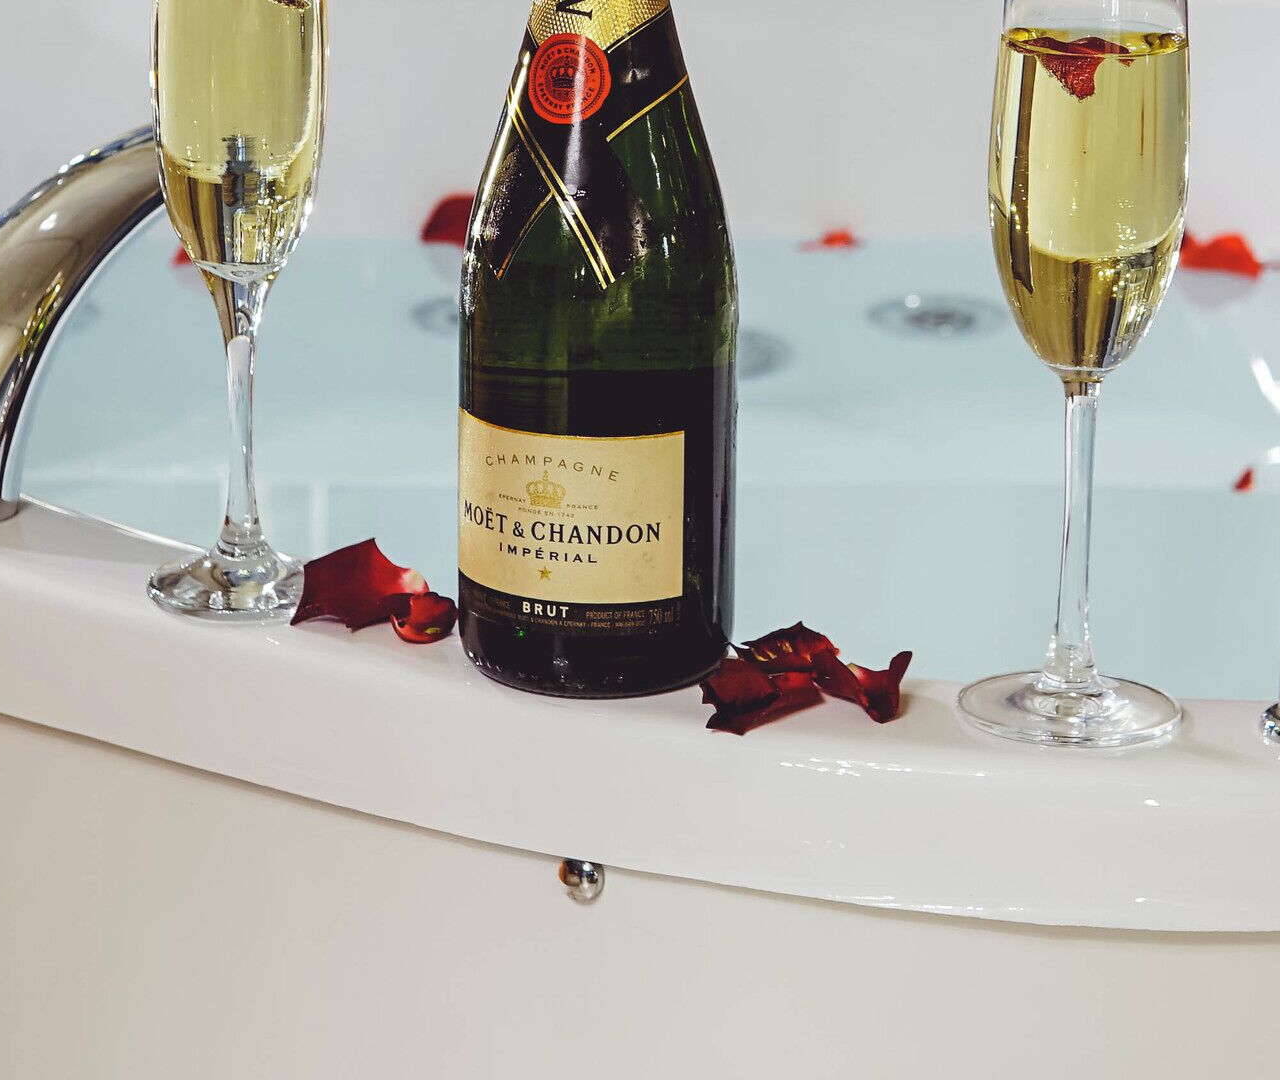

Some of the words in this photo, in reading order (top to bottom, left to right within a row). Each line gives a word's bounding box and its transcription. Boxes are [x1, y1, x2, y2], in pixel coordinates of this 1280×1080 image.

[564, 47, 596, 74] CHADON
[485, 454, 619, 482] CHAMPAGNE
[464, 499, 508, 534] MOËT
[512, 521, 526, 539] &
[531, 521, 661, 545] CHANDON
[499, 542, 598, 563] IMPÉRIAL
[522, 601, 569, 618] BRUT
[585, 610, 612, 620] PRODUCT
[623, 609, 645, 618] FRANCE
